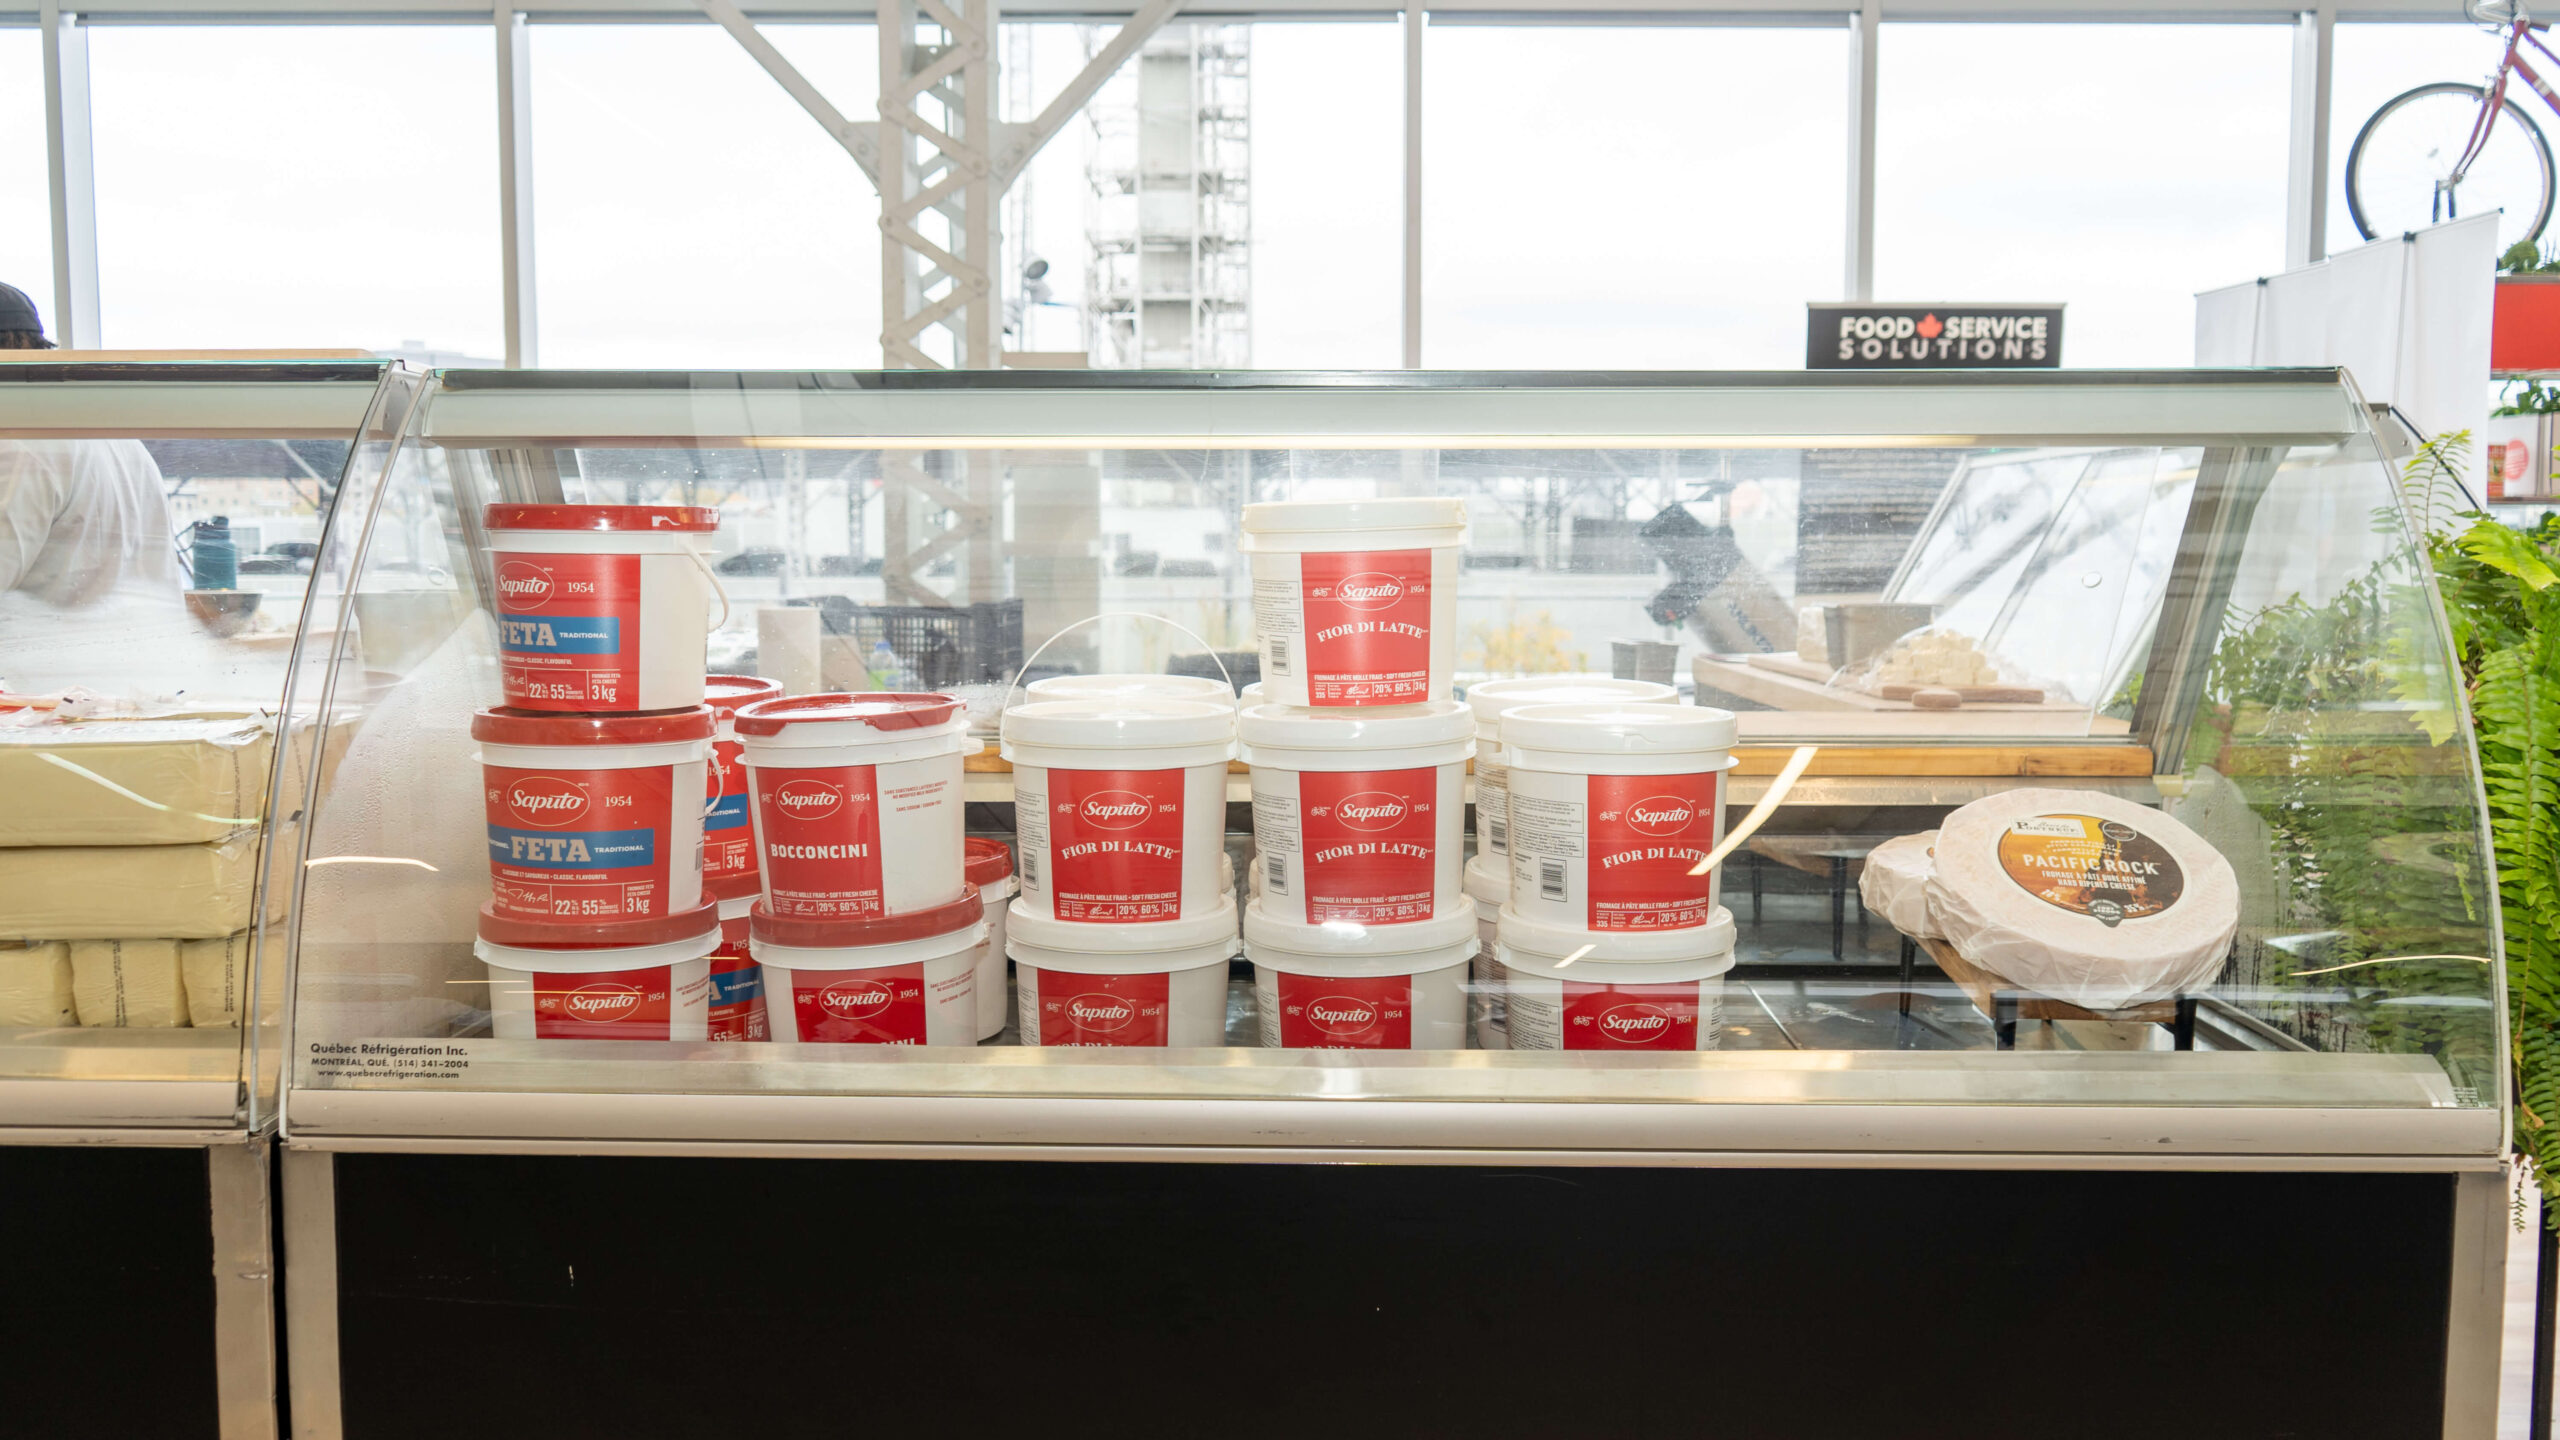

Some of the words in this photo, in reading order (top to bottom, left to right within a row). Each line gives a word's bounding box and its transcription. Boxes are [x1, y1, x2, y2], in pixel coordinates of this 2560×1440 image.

[1839, 316, 1915, 339] FOOD
[1944, 316, 2048, 339] SERVICE
[1838, 338, 2047, 360] SOLUTIONS
[499, 574, 550, 598] Saputo
[567, 581, 595, 593] 1954
[1340, 583, 1401, 602] Saputo
[1410, 585, 1425, 594] 1954
[500, 620, 557, 647] FETA
[559, 631, 609, 639] TRADITIONAL
[1316, 623, 1355, 643] FIOR
[1357, 621, 1375, 633] DI
[1379, 621, 1424, 639] LATTE
[529, 683, 542, 698] 22
[550, 684, 565, 699] 55
[511, 789, 585, 814] Saputo
[604, 795, 632, 807] 1954
[779, 791, 838, 810] Saputo
[850, 793, 870, 802] 1954
[1084, 801, 1148, 821] Saputo
[1159, 804, 1176, 813] 1954
[1340, 802, 1404, 822] Saputo
[1414, 804, 1430, 813] 1954
[1630, 807, 1691, 827] Saputo
[511, 835, 591, 862] FETA
[594, 844, 645, 853] TRADITIONAL
[770, 843, 868, 859] BOCCONCINI
[1061, 842, 1098, 860] FIOR
[1101, 840, 1119, 852] DI
[1124, 840, 1174, 860] LATTE
[1315, 844, 1354, 863] FIOR
[1358, 842, 1376, 855] DI
[1381, 842, 1428, 860] LATTE
[1602, 849, 1643, 869] FIOR
[1647, 847, 1665, 859] DI
[2022, 854, 2101, 871] PACIFIC
[2103, 858, 2159, 876] ROCK
[2042, 870, 2075, 879] FROMAGE
[2110, 881, 2136, 891] CHEESE
[555, 899, 571, 915] 22
[582, 899, 598, 915] 55
[732, 939, 748, 951] 195
[568, 993, 637, 1014] Saputo
[648, 992, 665, 1002] 1954
[823, 990, 888, 1010] Saputo
[900, 989, 918, 999] 1954
[1069, 1002, 1130, 1022] Saputo
[1141, 1007, 1160, 1017] 1954
[1310, 1005, 1373, 1025] Saputo
[1384, 1010, 1403, 1020] 1954
[1676, 1015, 1692, 1025] 1954
[1603, 1014, 1667, 1033] Saputo
[310, 1043, 357, 1055] Québec
[361, 1043, 442, 1057] Réfrigération
[446, 1045, 468, 1056] Inc.
[311, 1057, 365, 1067] MONTRÉAL,
[367, 1058, 390, 1067] QUÉ.
[393, 1059, 418, 1068] (514)
[421, 1060, 469, 1068] 341-2004
[318, 1069, 460, 1079] www.quebecrefrigeration.com
